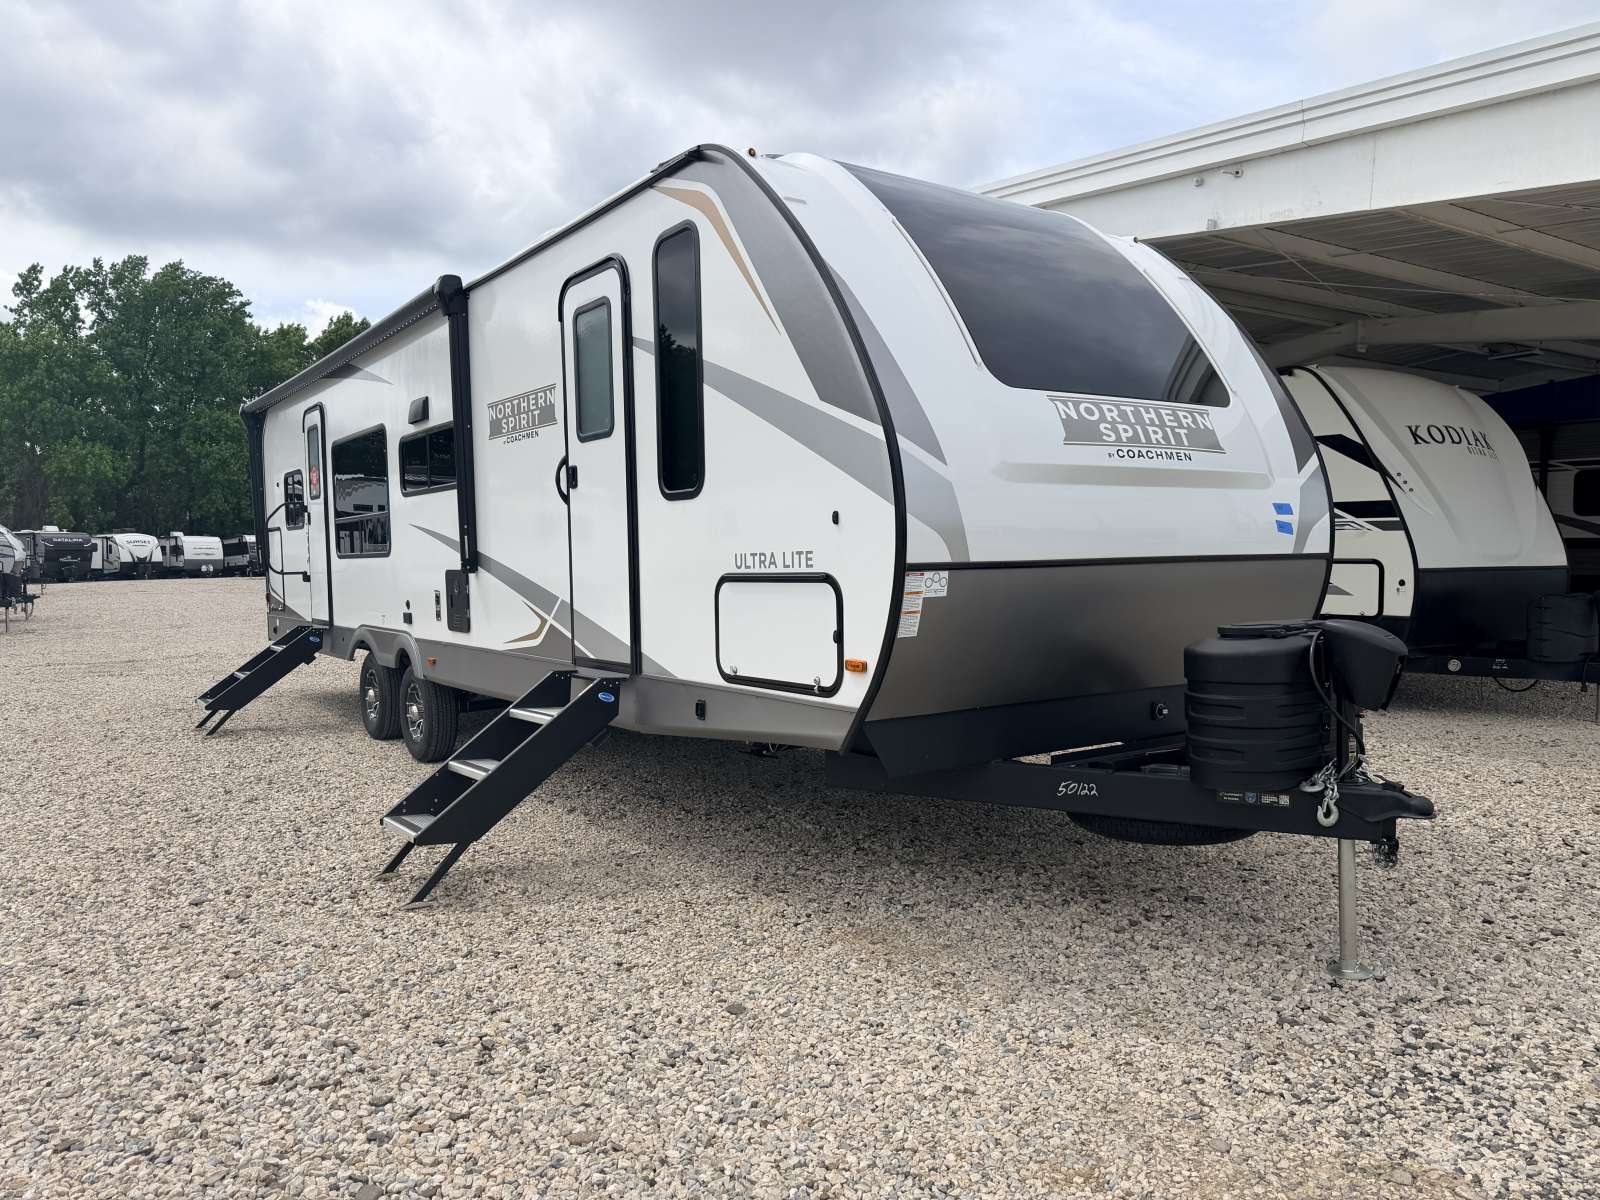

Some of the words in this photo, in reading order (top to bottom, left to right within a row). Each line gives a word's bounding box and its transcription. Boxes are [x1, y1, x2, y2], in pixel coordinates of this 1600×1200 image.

[489, 389, 555, 421] NORTHERN
[1054, 401, 1214, 432] NORTHERN
[502, 410, 540, 433] SPIRIT
[506, 430, 539, 444] COACHMEN
[1099, 423, 1189, 447] SPIRIT
[1405, 424, 1496, 453] KODIAK
[1116, 448, 1193, 462] COACHMEN
[734, 551, 778, 570] ULTRA
[782, 550, 814, 569] LITE
[1056, 781, 1099, 798] 50122
